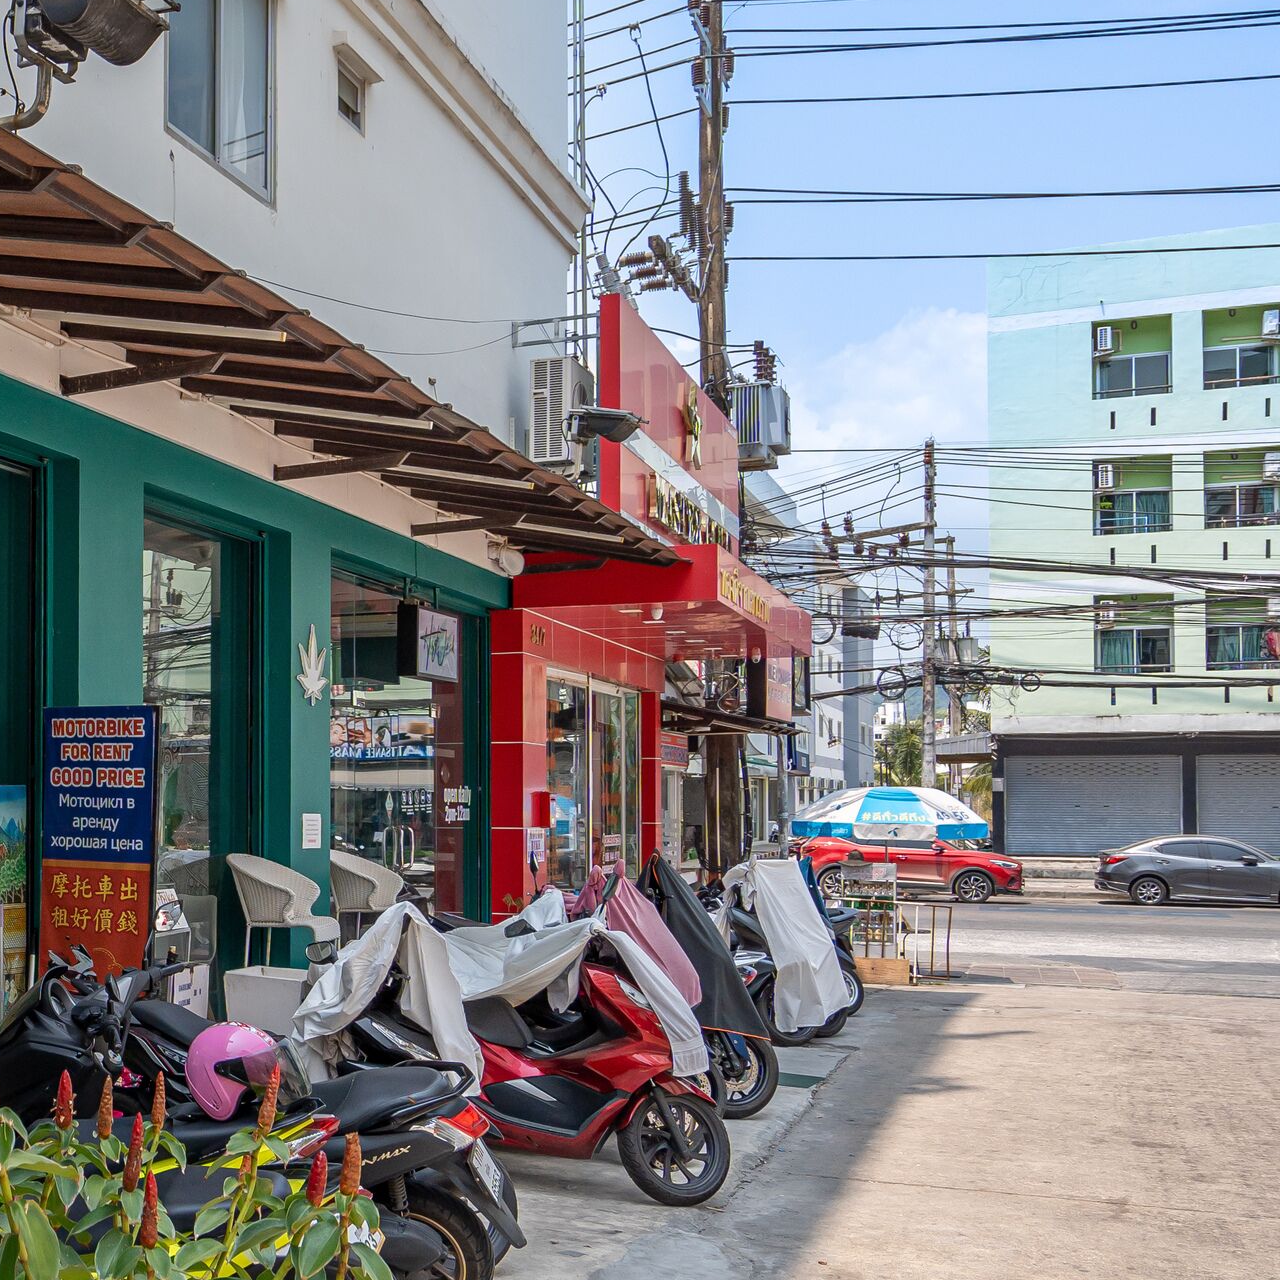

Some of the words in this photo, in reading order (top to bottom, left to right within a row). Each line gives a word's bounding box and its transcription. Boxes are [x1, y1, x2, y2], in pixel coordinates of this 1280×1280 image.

[51, 717, 145, 738] MOTORBIKE
[60, 743, 90, 761] FOR
[93, 742, 133, 762] RENT
[50, 767, 93, 787] GOOD
[96, 767, 145, 788] PRICE
[58, 793, 123, 811] Мотоцикл
[127, 797, 135, 810] в
[72, 817, 119, 832] аренду
[50, 836, 108, 851] хорошая
[110, 837, 144, 851] цена
[50, 872, 138, 902] 摩托車出
[51, 908, 139, 936] 租好價錢
